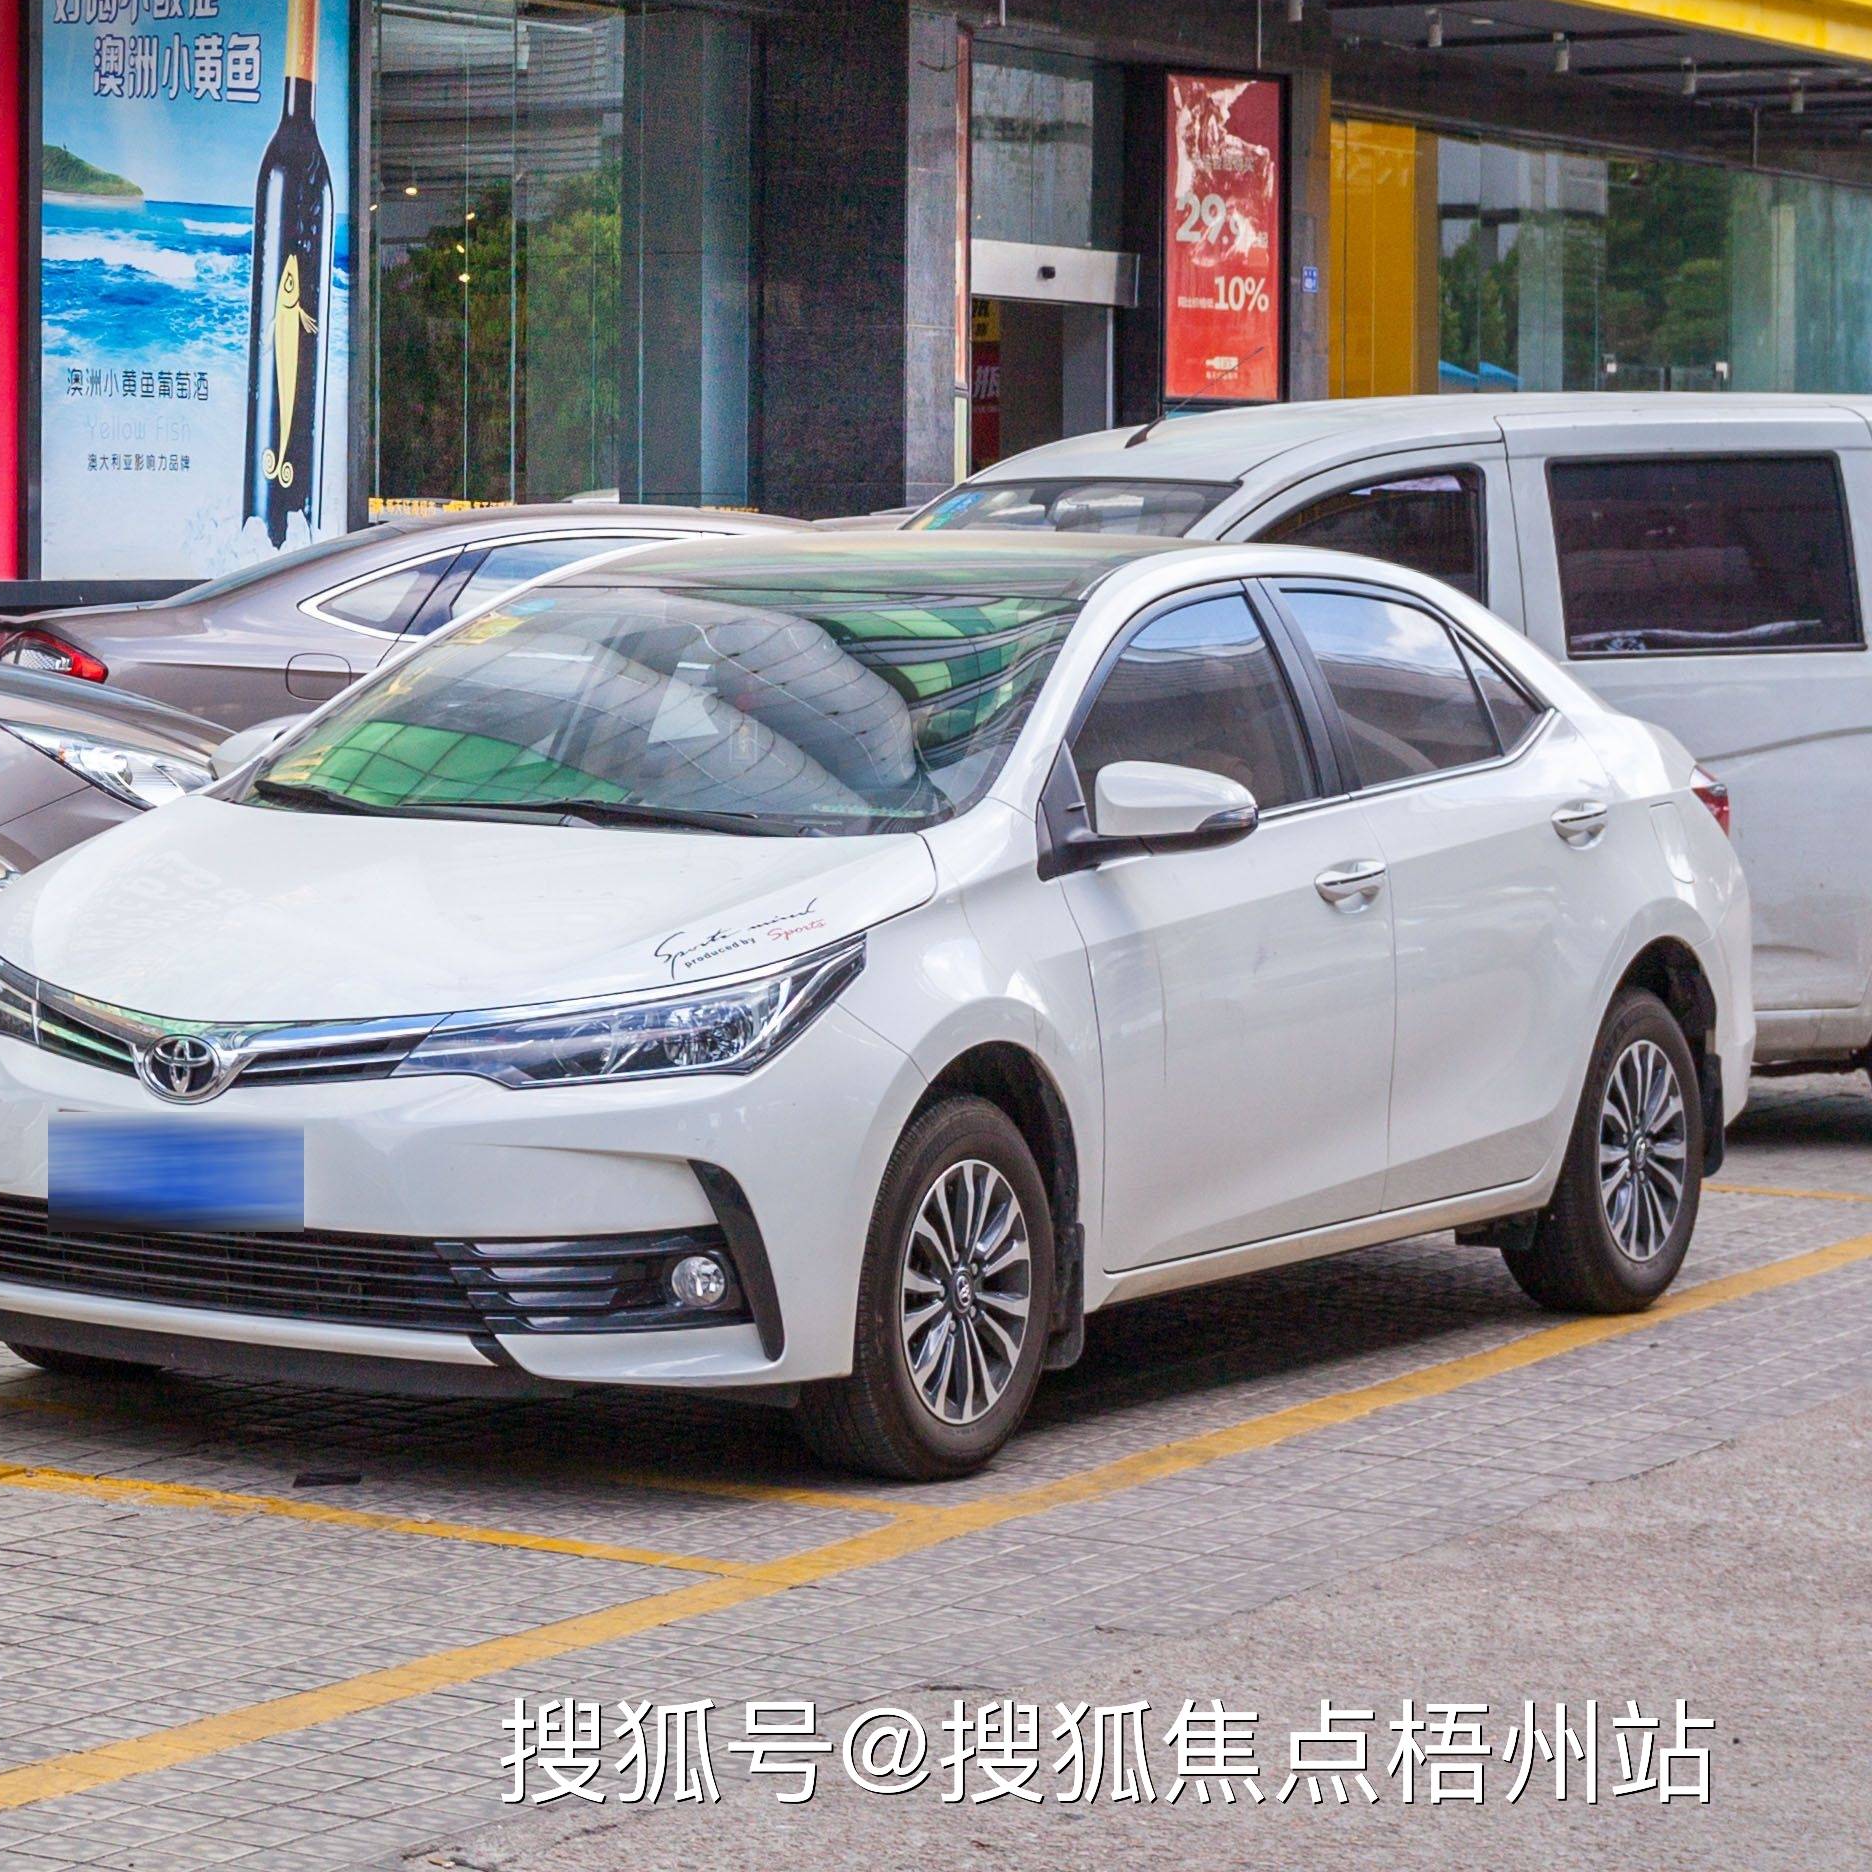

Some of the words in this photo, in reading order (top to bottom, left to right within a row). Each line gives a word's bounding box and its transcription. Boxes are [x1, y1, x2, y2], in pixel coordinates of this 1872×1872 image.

[92, 32, 262, 104] 澳洲小黄鱼
[66, 367, 209, 401] 澳洲小黄鱼葡萄酒
[87, 453, 190, 473] 澳大利亚影响力品牌
[767, 918, 827, 941] Sports
